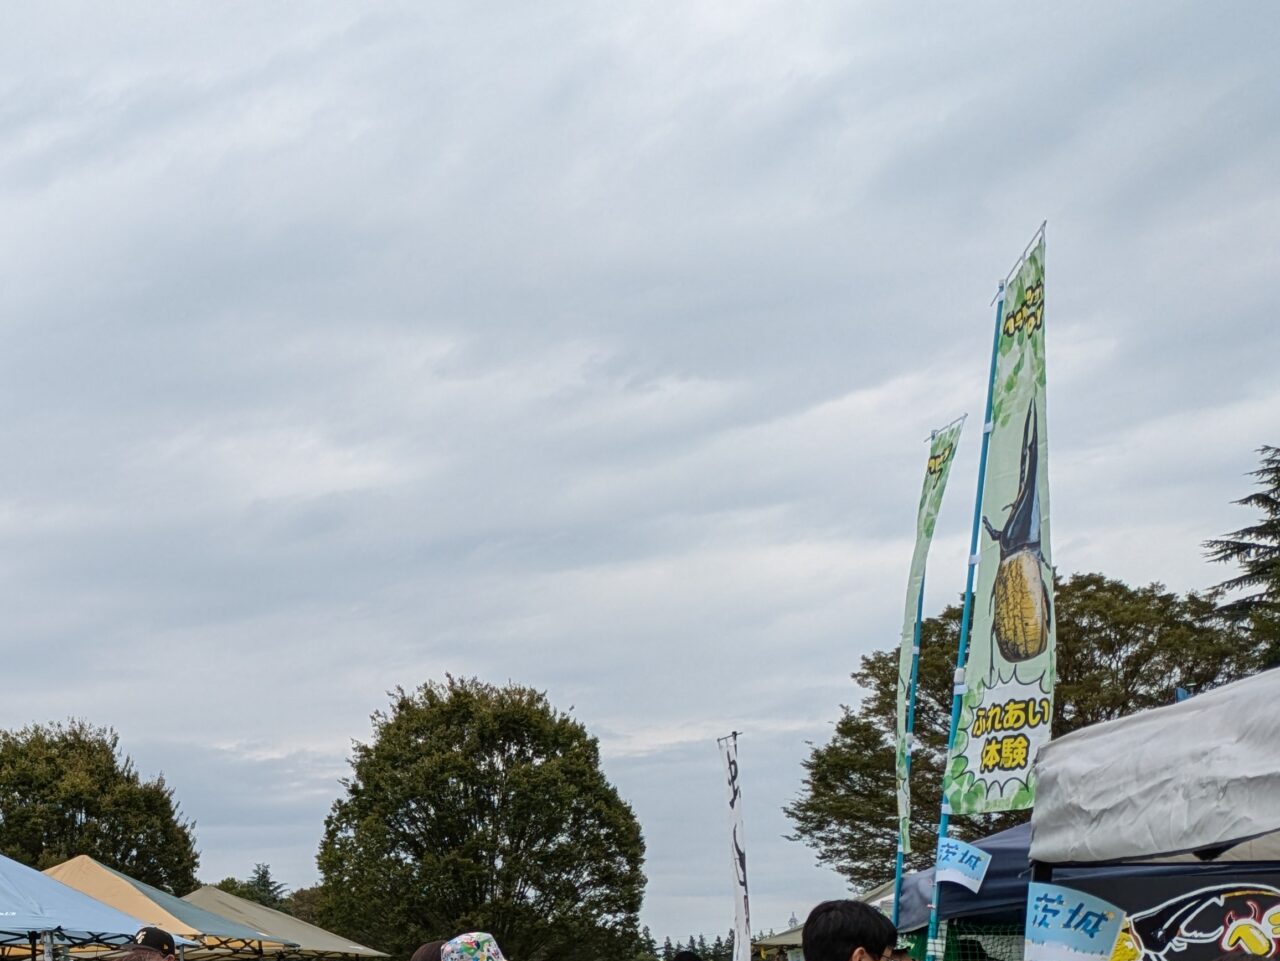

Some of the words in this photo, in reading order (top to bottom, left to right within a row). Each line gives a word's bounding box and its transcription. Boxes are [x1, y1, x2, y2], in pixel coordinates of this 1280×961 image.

[972, 698, 1050, 738] ふれあい
[980, 733, 1030, 774] 体験
[938, 843, 981, 870] 茨城
[1032, 893, 1109, 938] 茨城
